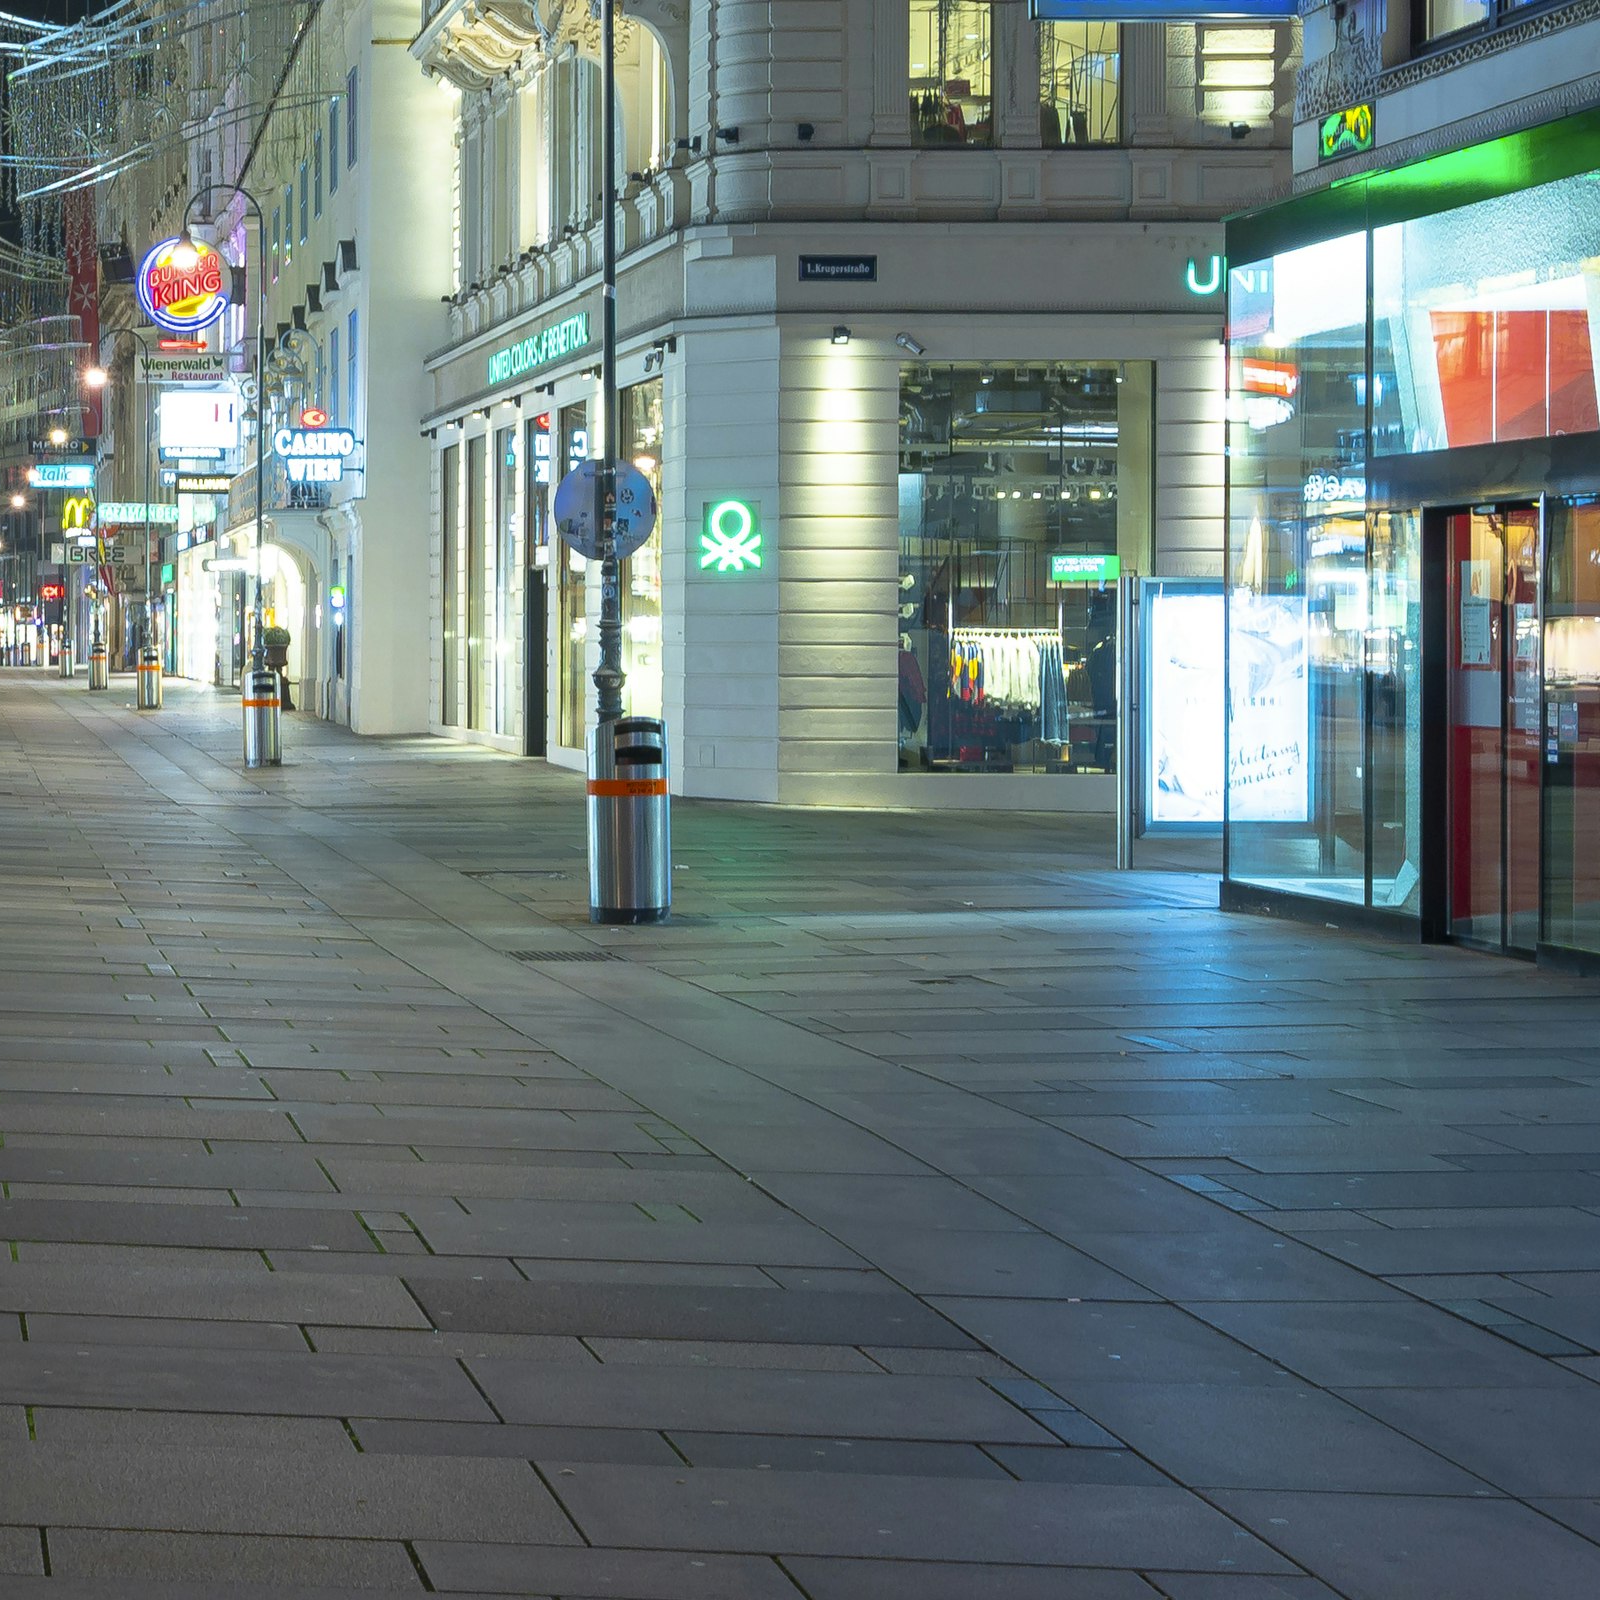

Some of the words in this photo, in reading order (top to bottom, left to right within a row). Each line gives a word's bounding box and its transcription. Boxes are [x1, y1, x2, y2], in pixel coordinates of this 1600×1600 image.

[150, 253, 218, 289] BUER
[154, 271, 221, 310] KING
[140, 356, 210, 371] Wienerwald
[488, 348, 512, 385] UNITED
[511, 335, 538, 376] COLORS
[171, 371, 224, 381] Restaurant
[275, 428, 354, 456] CASINO
[286, 458, 342, 481] WIEN
